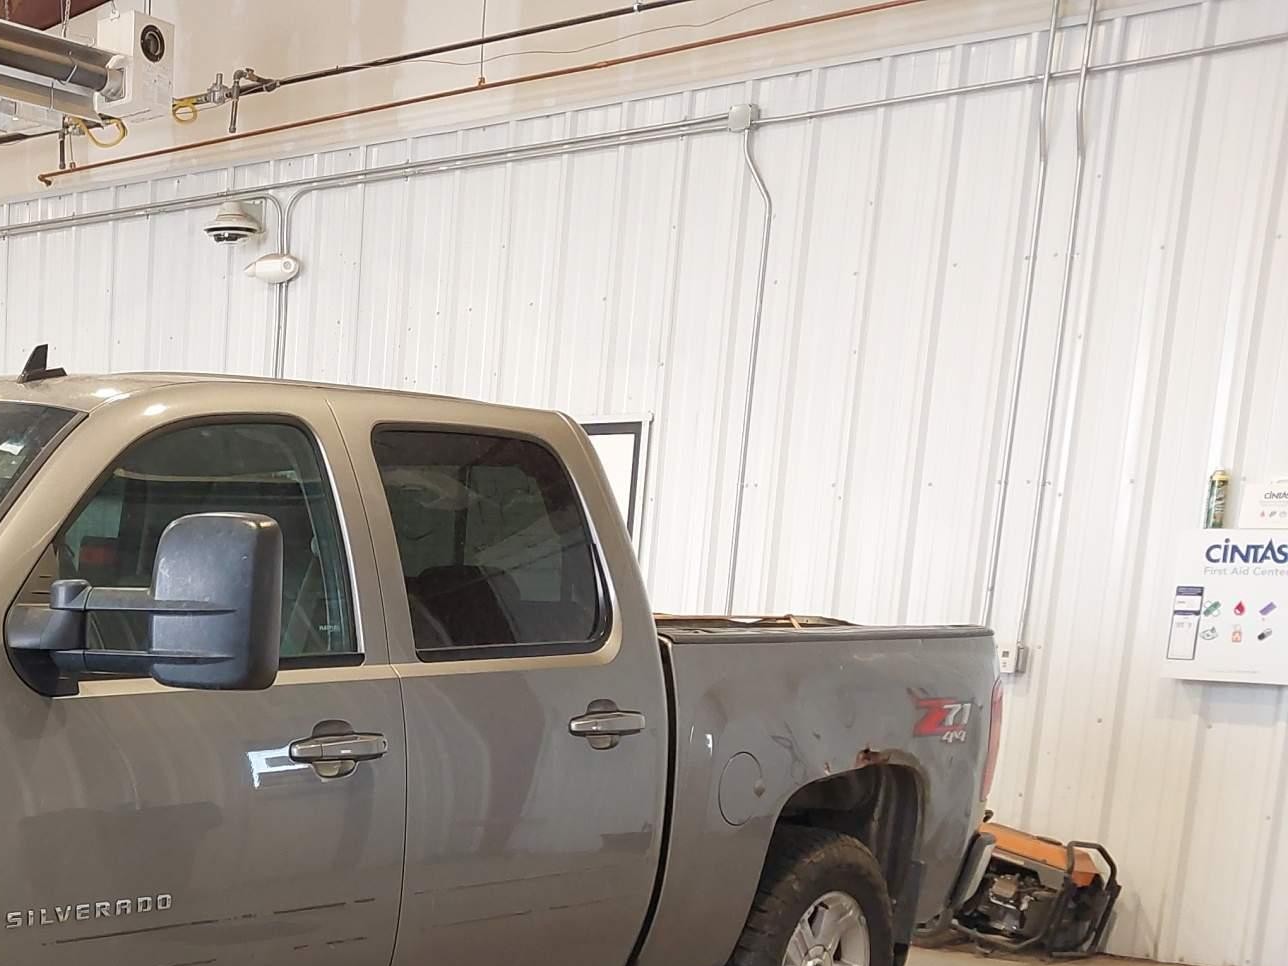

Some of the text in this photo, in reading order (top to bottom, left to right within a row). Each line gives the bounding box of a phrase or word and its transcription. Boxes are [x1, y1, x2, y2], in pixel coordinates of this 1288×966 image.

[1204, 566, 1288, 577] First Aid Cente
[913, 698, 972, 737] Z71
[5, 893, 172, 929] SILVERADO
